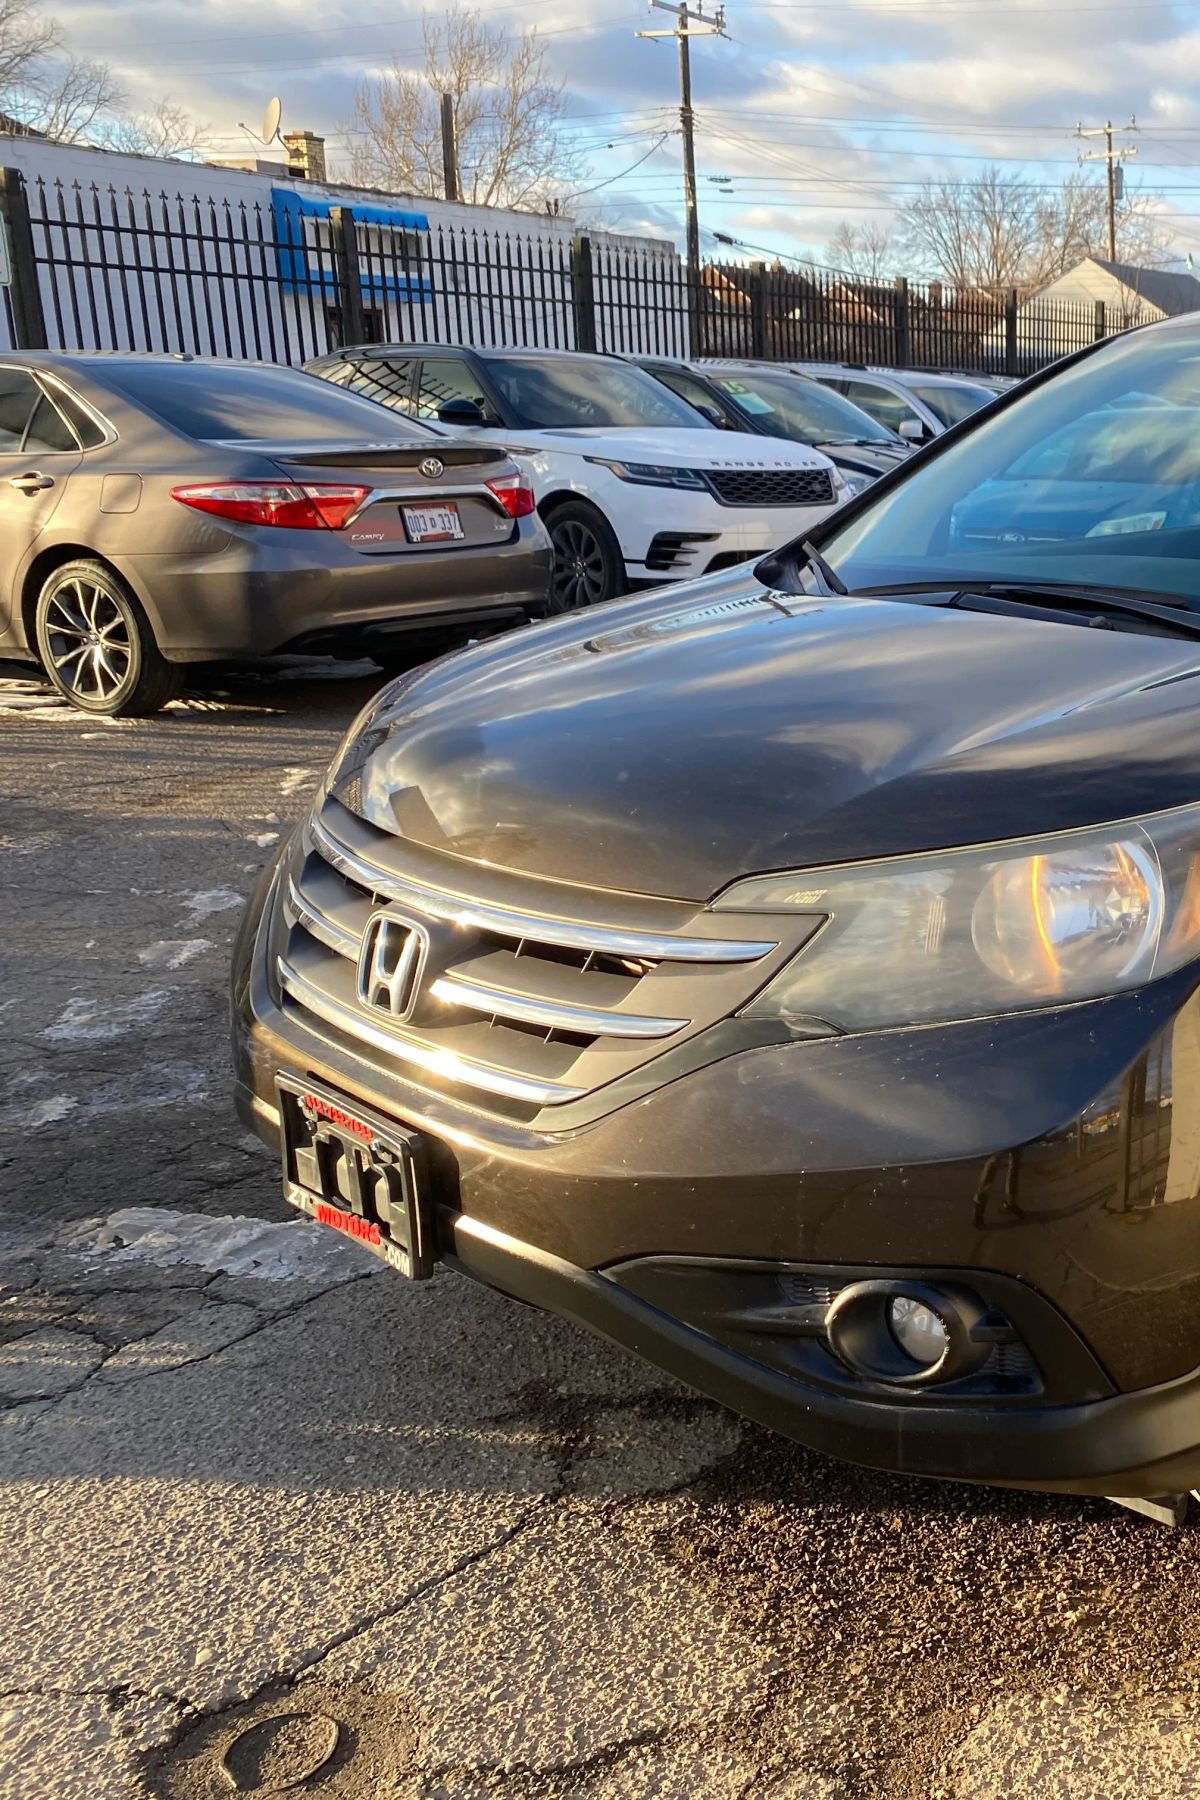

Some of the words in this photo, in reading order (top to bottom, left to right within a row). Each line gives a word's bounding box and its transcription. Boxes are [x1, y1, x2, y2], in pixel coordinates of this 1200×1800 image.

[720, 380, 746, 394] 15
[710, 460, 766, 468] RANGE
[407, 514, 428, 533] 003
[438, 512, 457, 531] 337
[351, 533, 385, 541] CAMRY
[288, 1184, 309, 1210] ZT
[316, 1204, 381, 1246] MOTORS
